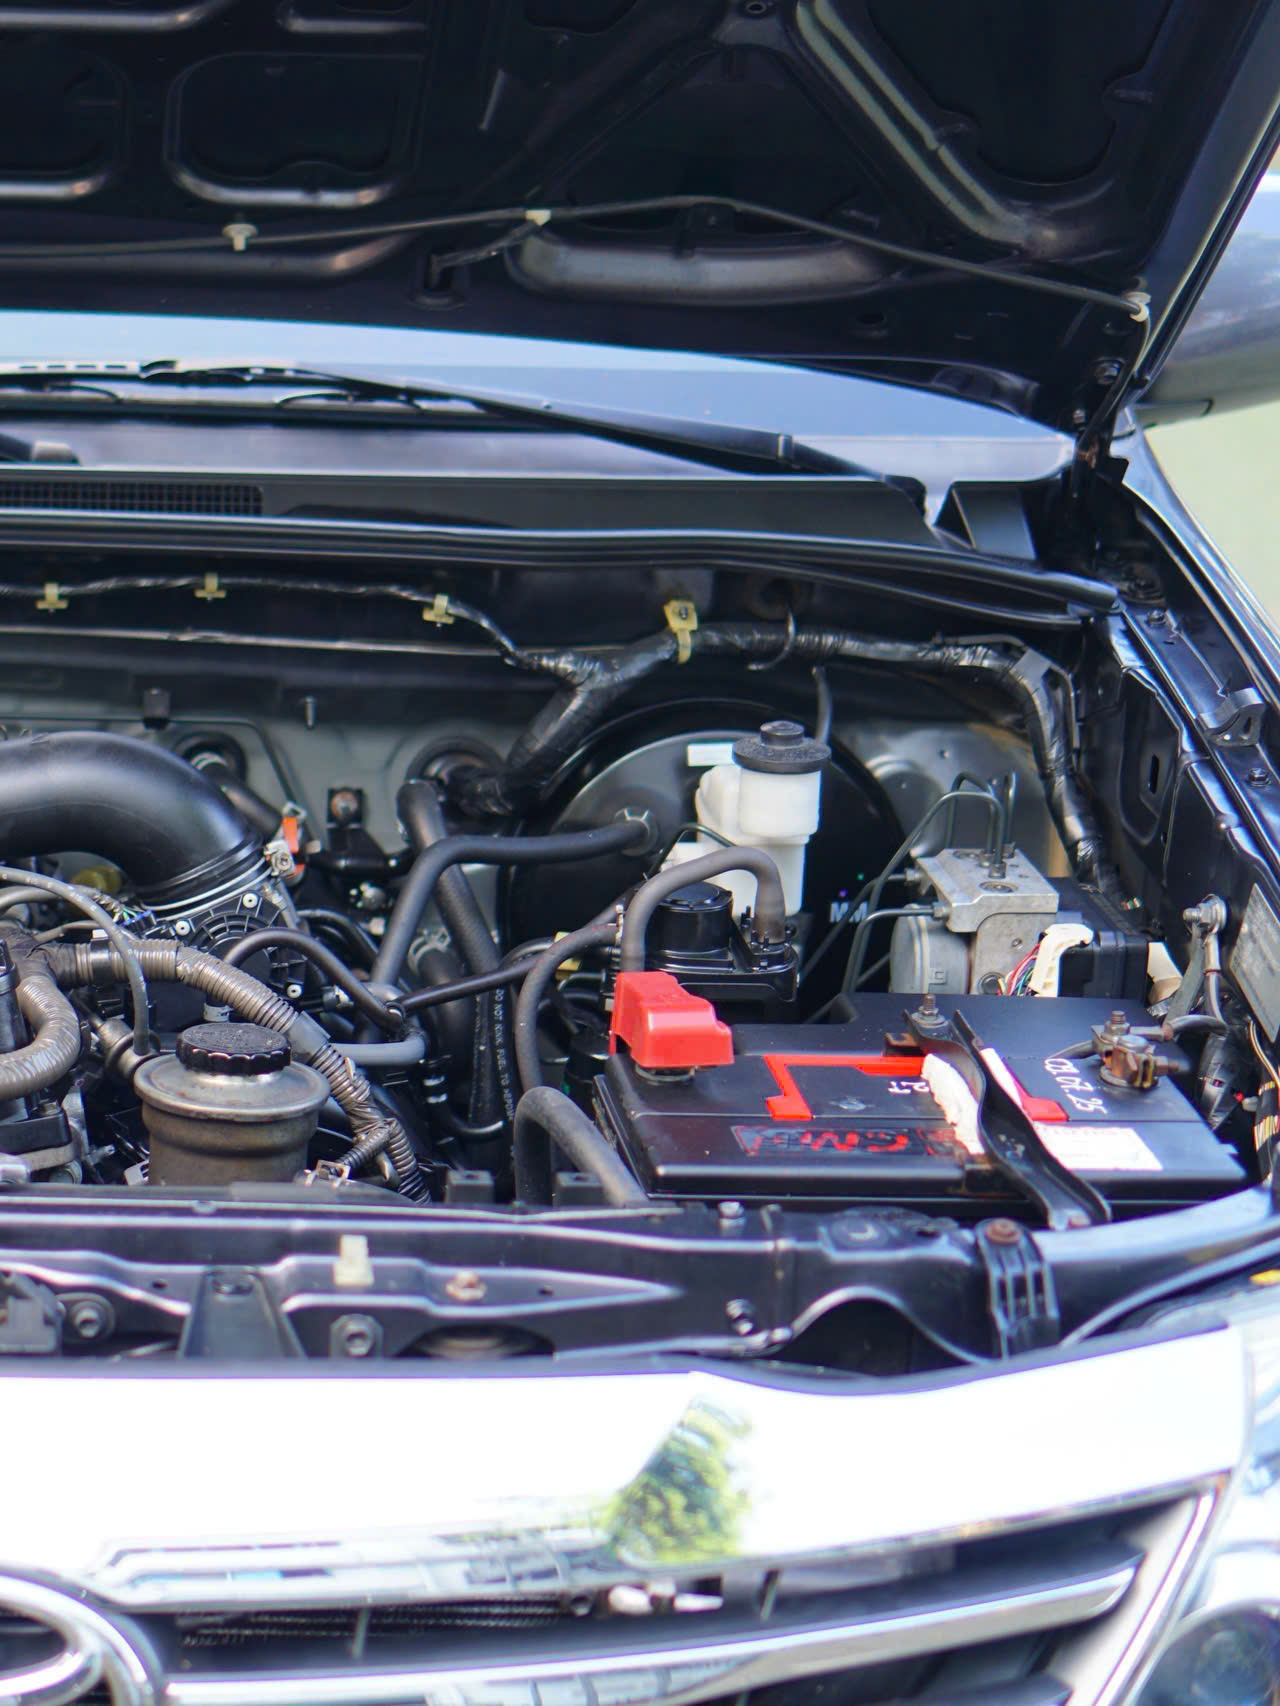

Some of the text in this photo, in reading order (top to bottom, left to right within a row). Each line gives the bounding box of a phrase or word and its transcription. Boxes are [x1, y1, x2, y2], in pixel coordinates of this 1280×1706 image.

[494, 988, 505, 1001] DO
[493, 1003, 504, 1021] NOT
[496, 1048, 507, 1071] FUEL
